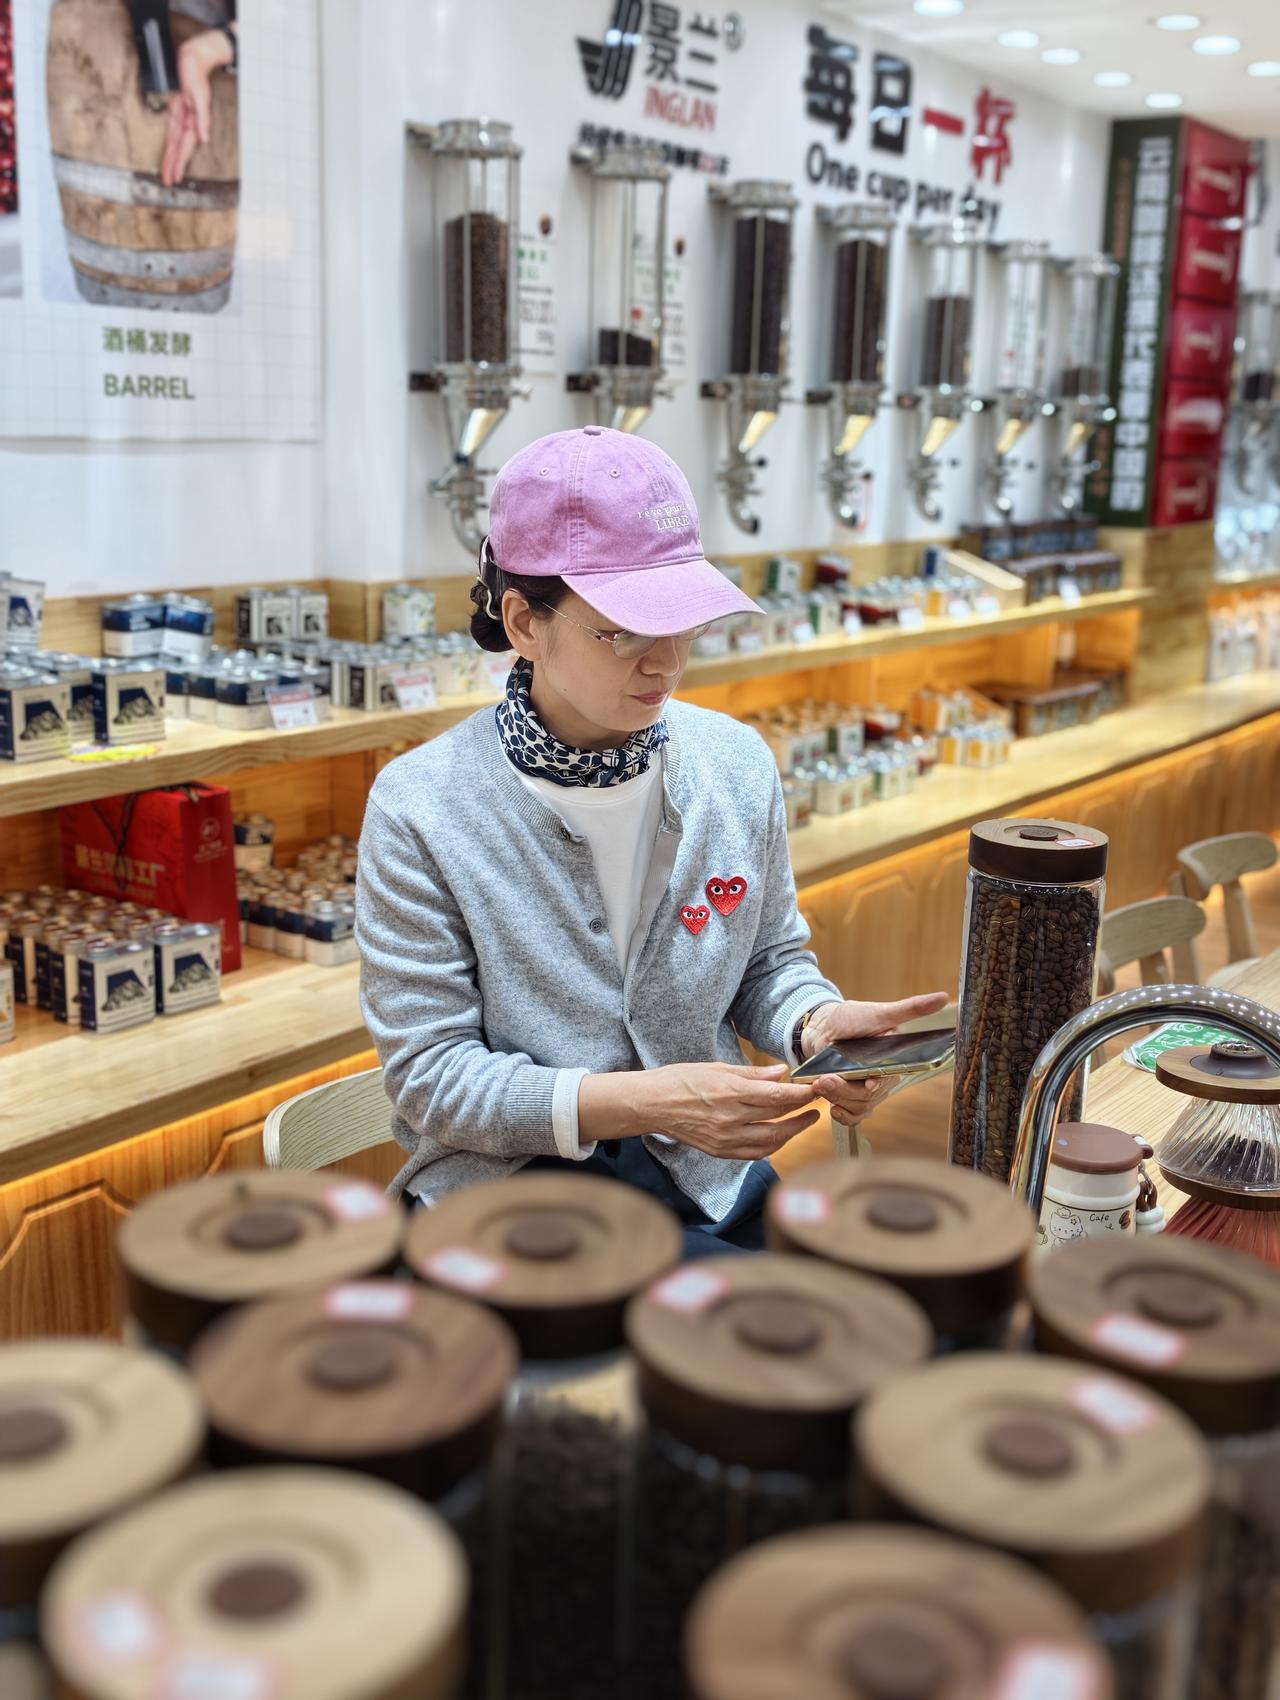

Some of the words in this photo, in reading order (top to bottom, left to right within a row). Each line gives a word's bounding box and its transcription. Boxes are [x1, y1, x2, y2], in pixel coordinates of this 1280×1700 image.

[644, 0, 719, 94] 景兰
[806, 143, 859, 191] One
[866, 171, 910, 212] cup
[914, 181, 953, 219] per
[102, 325, 192, 357] 酒桶发酵
[103, 372, 196, 401] BARREL
[655, 514, 690, 531] LIBRE
